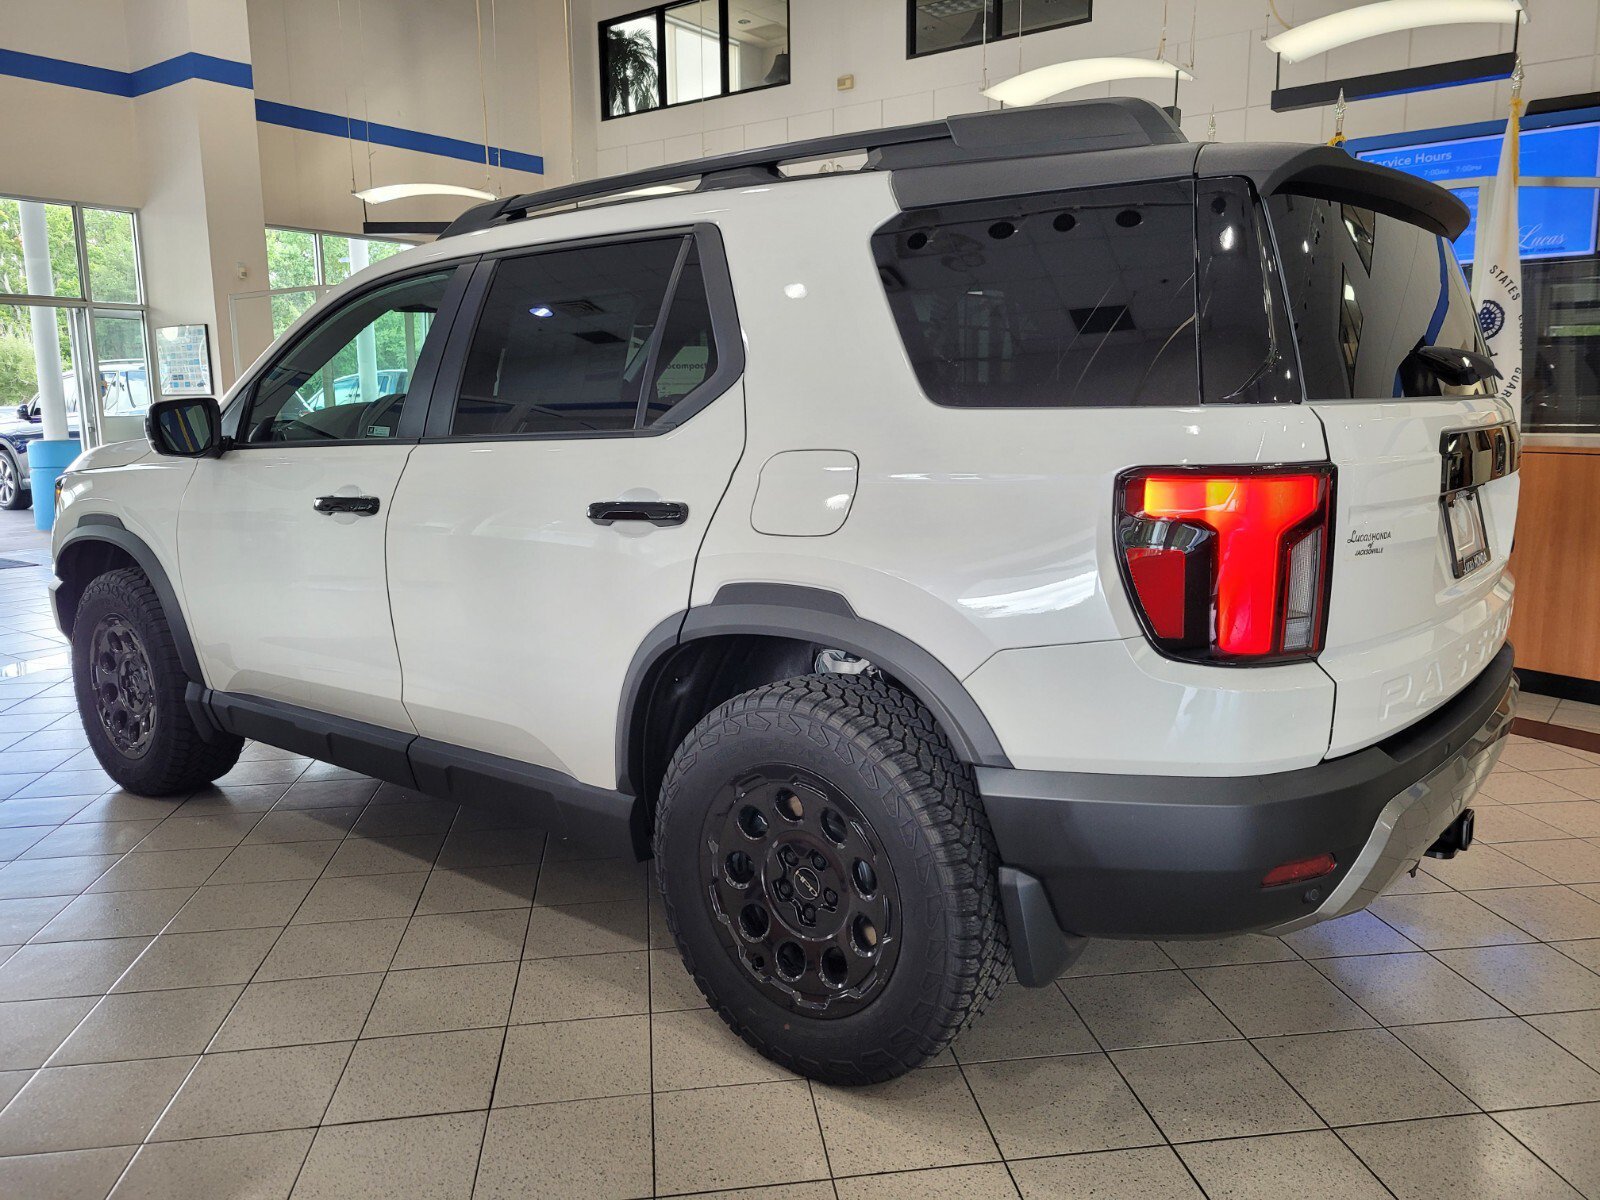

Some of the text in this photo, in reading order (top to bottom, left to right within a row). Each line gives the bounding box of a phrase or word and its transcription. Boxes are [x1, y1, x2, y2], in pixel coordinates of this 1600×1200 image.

[1415, 152, 1452, 164] Hours
[1518, 223, 1565, 249] Lucas
[1489, 265, 1521, 301] STATES
[1501, 367, 1521, 398] GUAR
[1371, 531, 1391, 541] HONDA
